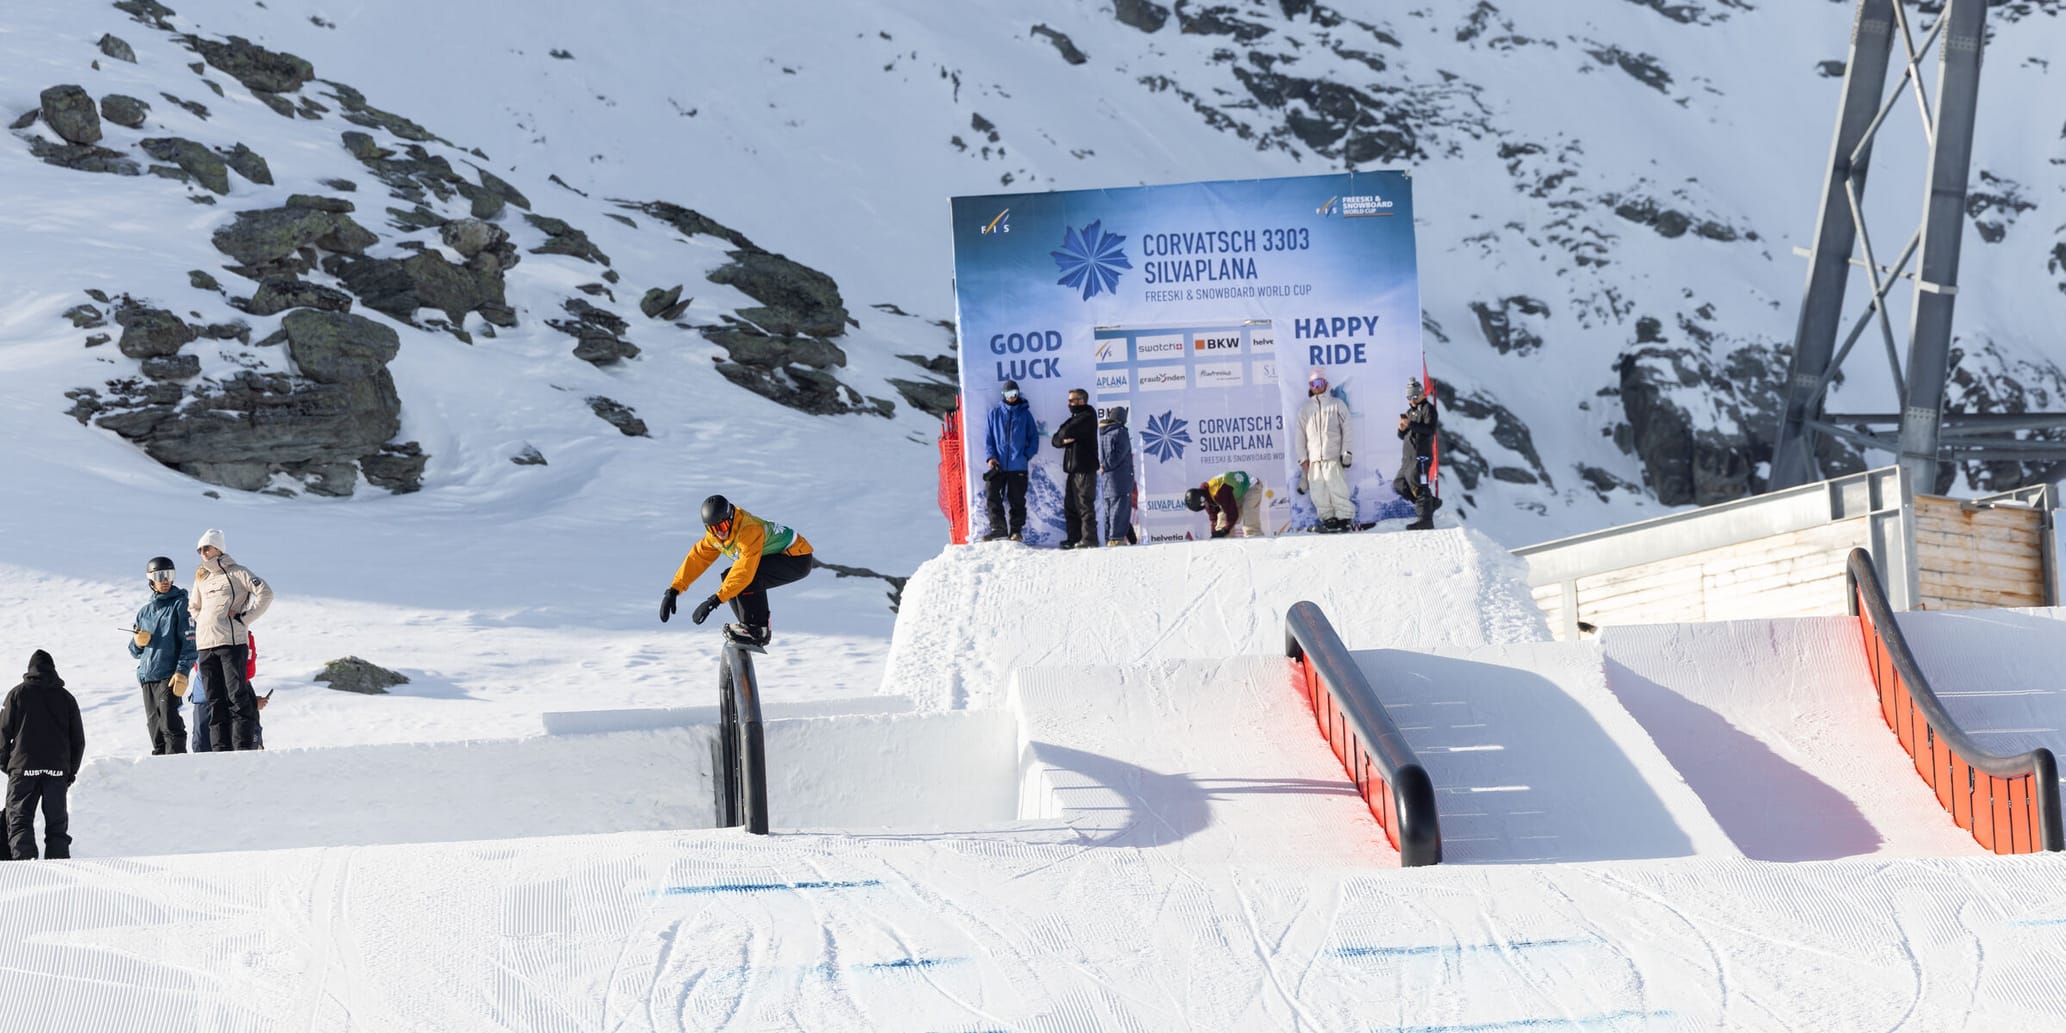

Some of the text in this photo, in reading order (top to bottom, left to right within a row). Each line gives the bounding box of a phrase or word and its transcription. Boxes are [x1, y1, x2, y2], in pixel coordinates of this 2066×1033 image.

[981, 224, 1010, 234] FIS
[1143, 228, 1309, 256] CORVATSCH 3303
[1145, 257, 1258, 284] SILVAPLANA
[1146, 284, 1312, 302] FREESKI & SNOWBOARD WORLD CUP
[1295, 316, 1379, 339] HAPPY
[989, 330, 1062, 355] GOOD
[1139, 343, 1176, 353] swatch
[1207, 338, 1240, 349] BKW
[1253, 338, 1274, 346] helve
[1309, 343, 1367, 366] RIDE
[996, 357, 1061, 382] LUCK
[1096, 376, 1127, 386] APLANA
[1199, 415, 1283, 434] CORVATSCH 3
[1200, 434, 1273, 452] SILVAPLANA
[1200, 455, 1226, 464] FREESKI
[1233, 452, 1271, 462] SNOWBOARD
[1147, 499, 1187, 511] SILVAPLAN
[1151, 533, 1184, 542] helvetia
